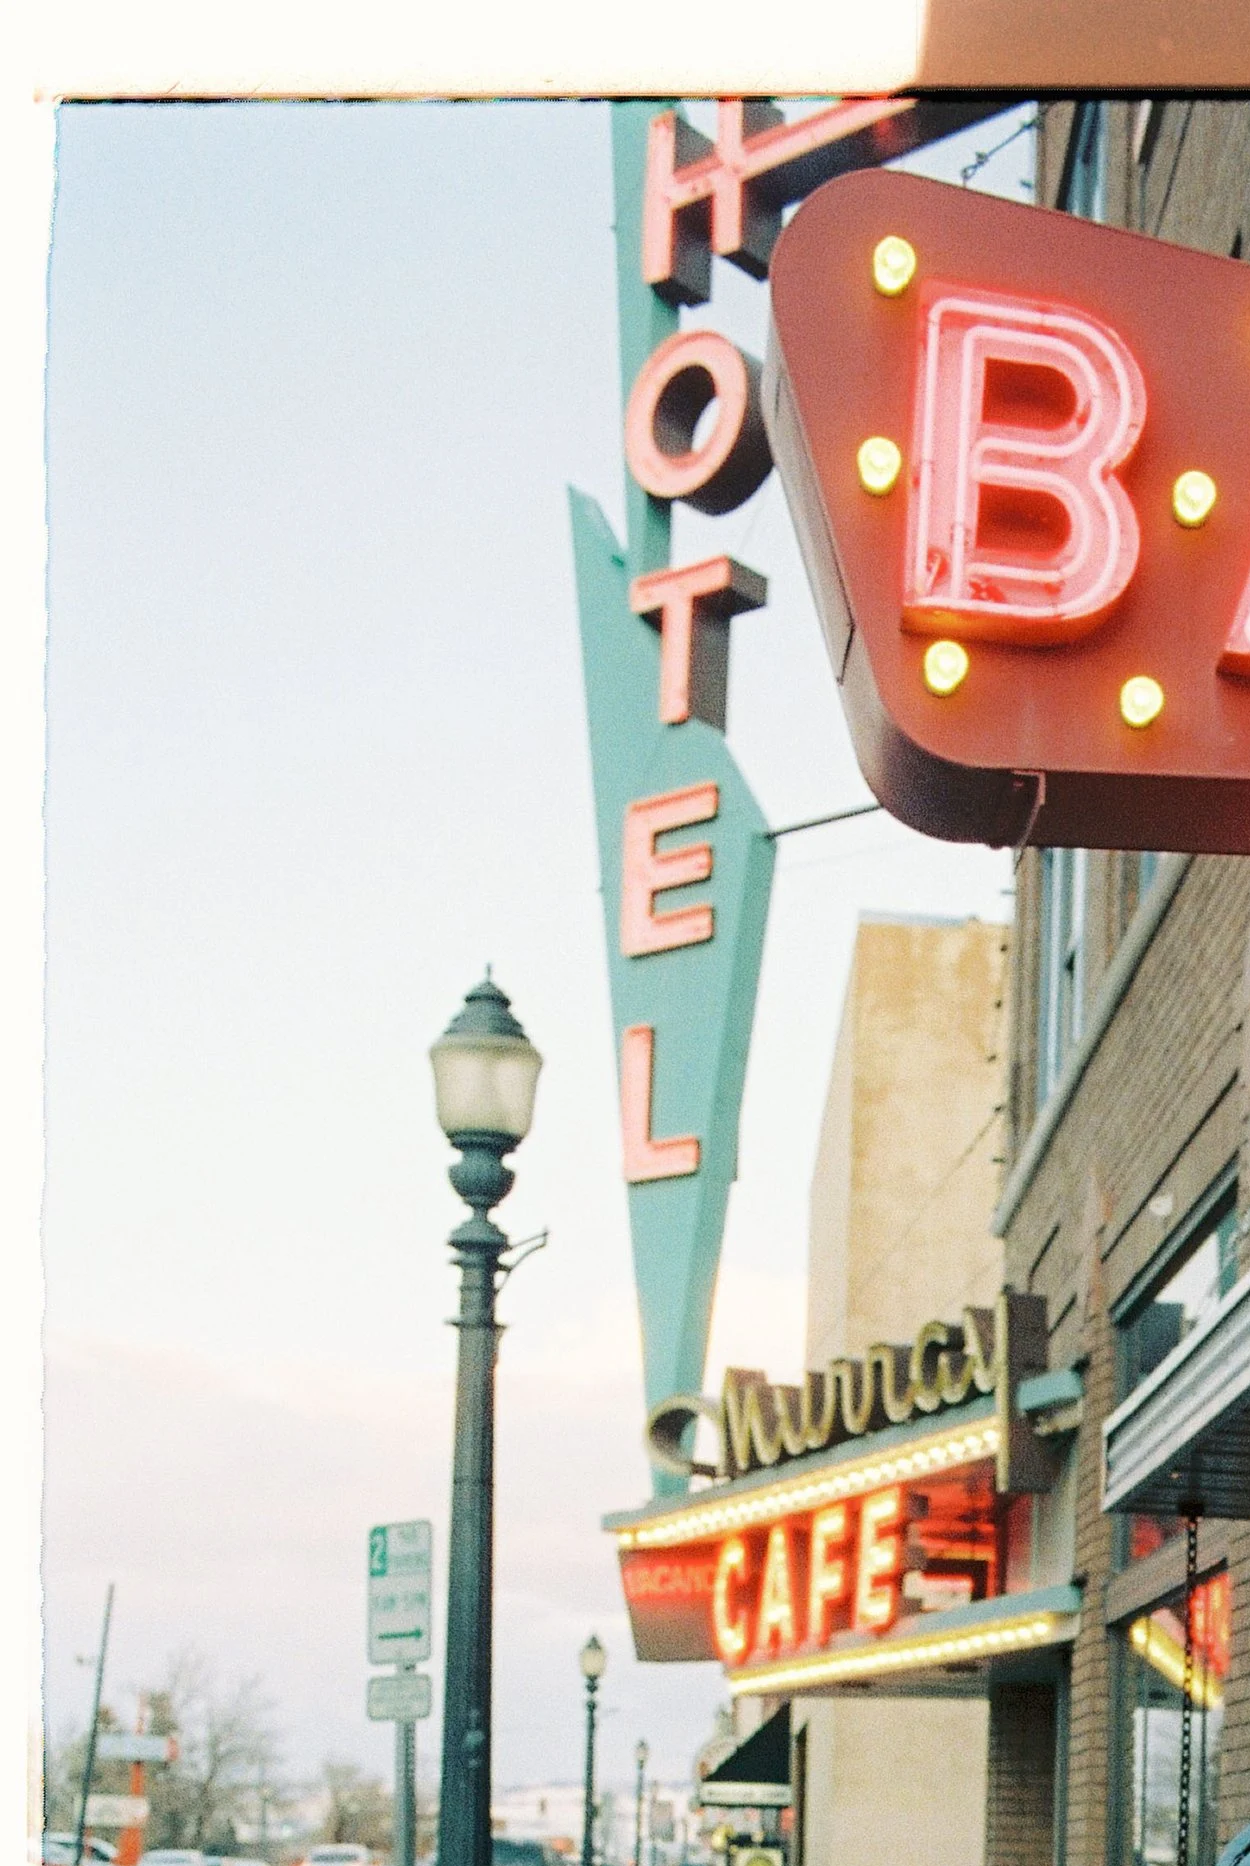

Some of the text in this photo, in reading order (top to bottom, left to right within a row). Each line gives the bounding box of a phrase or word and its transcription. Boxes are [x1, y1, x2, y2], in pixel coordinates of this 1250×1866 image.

[620, 100, 746, 1182] HOTEL
[644, 1290, 1012, 1494] Murray
[714, 1487, 902, 1658] CAFE
